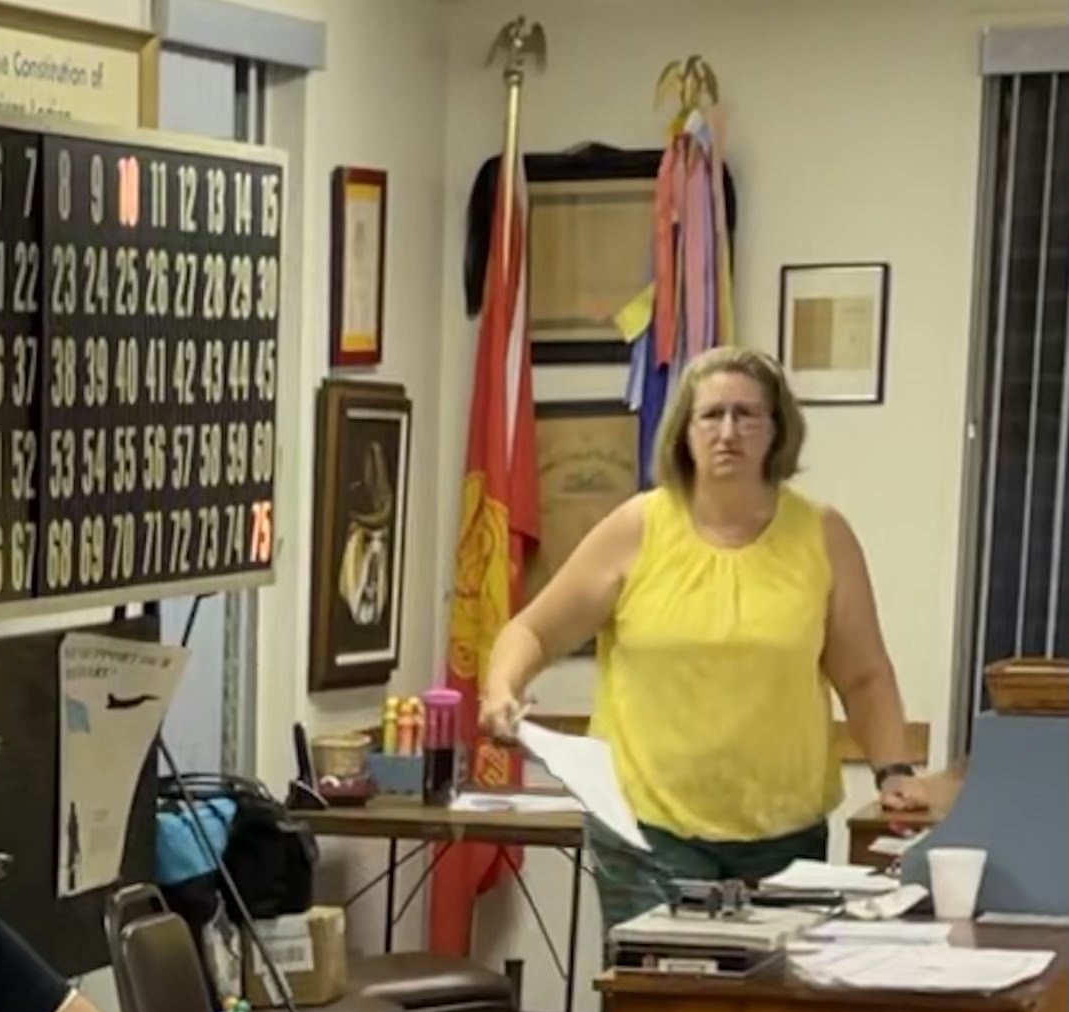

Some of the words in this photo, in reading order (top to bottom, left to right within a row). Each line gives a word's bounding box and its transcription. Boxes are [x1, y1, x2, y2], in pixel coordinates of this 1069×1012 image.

[12, 52, 87, 86] Constitution
[89, 62, 104, 90] of
[24, 148, 37, 217] 7
[58, 150, 72, 220] 8
[90, 155, 104, 224] 9
[118, 156, 139, 227] 10
[150, 161, 167, 227] 11
[178, 165, 198, 231] 12
[206, 168, 225, 234] 13
[234, 171, 252, 235] 14
[261, 174, 278, 236] 15
[13, 241, 39, 312] 22
[52, 244, 76, 314] 23
[84, 246, 108, 314] 24
[115, 247, 139, 315] 25
[146, 247, 168, 315] 26
[174, 253, 197, 317] 27
[203, 253, 226, 319] 28
[231, 254, 252, 319] 29
[257, 256, 278, 319] 30
[13, 336, 37, 406] 37
[51, 337, 76, 407] 38
[84, 337, 108, 407] 39
[114, 337, 139, 405] 40
[146, 338, 166, 403] 41
[173, 339, 196, 404] 42
[201, 340, 224, 404] 43
[229, 340, 250, 401] 44
[254, 339, 275, 401] 45
[11, 430, 36, 499] 52
[49, 429, 75, 499] 53
[81, 427, 106, 496] 54
[113, 426, 136, 493] 55
[143, 425, 166, 490] 56
[172, 425, 195, 490] 57
[199, 424, 221, 487] 58
[226, 422, 247, 484] 59
[11, 522, 36, 591] 67
[47, 518, 74, 588] 68
[80, 516, 105, 585] 69
[111, 513, 135, 580] 70
[143, 511, 162, 574] 71
[169, 509, 192, 573] 72
[197, 506, 219, 569] 73
[225, 504, 245, 566] 74
[250, 501, 271, 563] 75
